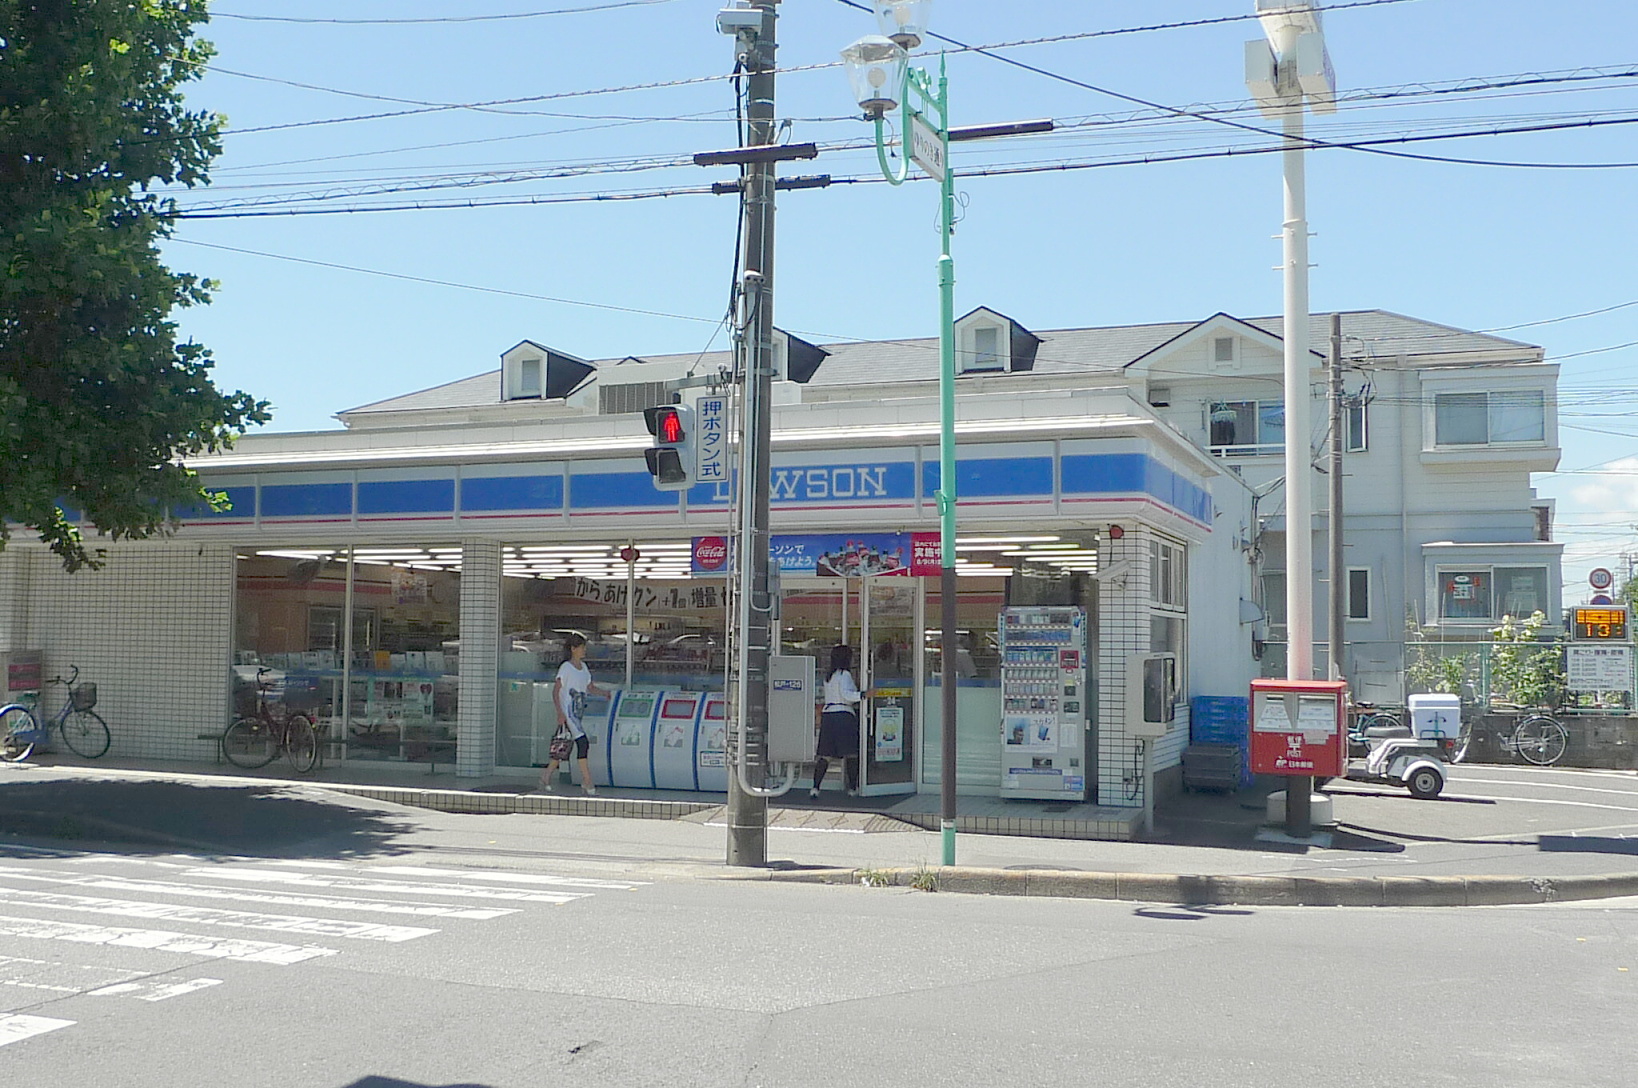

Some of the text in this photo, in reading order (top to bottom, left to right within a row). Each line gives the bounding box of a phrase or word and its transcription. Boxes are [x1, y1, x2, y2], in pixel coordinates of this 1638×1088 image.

[702, 401, 722, 477] 押ボタン式
[713, 467, 887, 501] LWSON
[696, 545, 726, 558] Coca-Cola
[1594, 573, 1607, 584] 30
